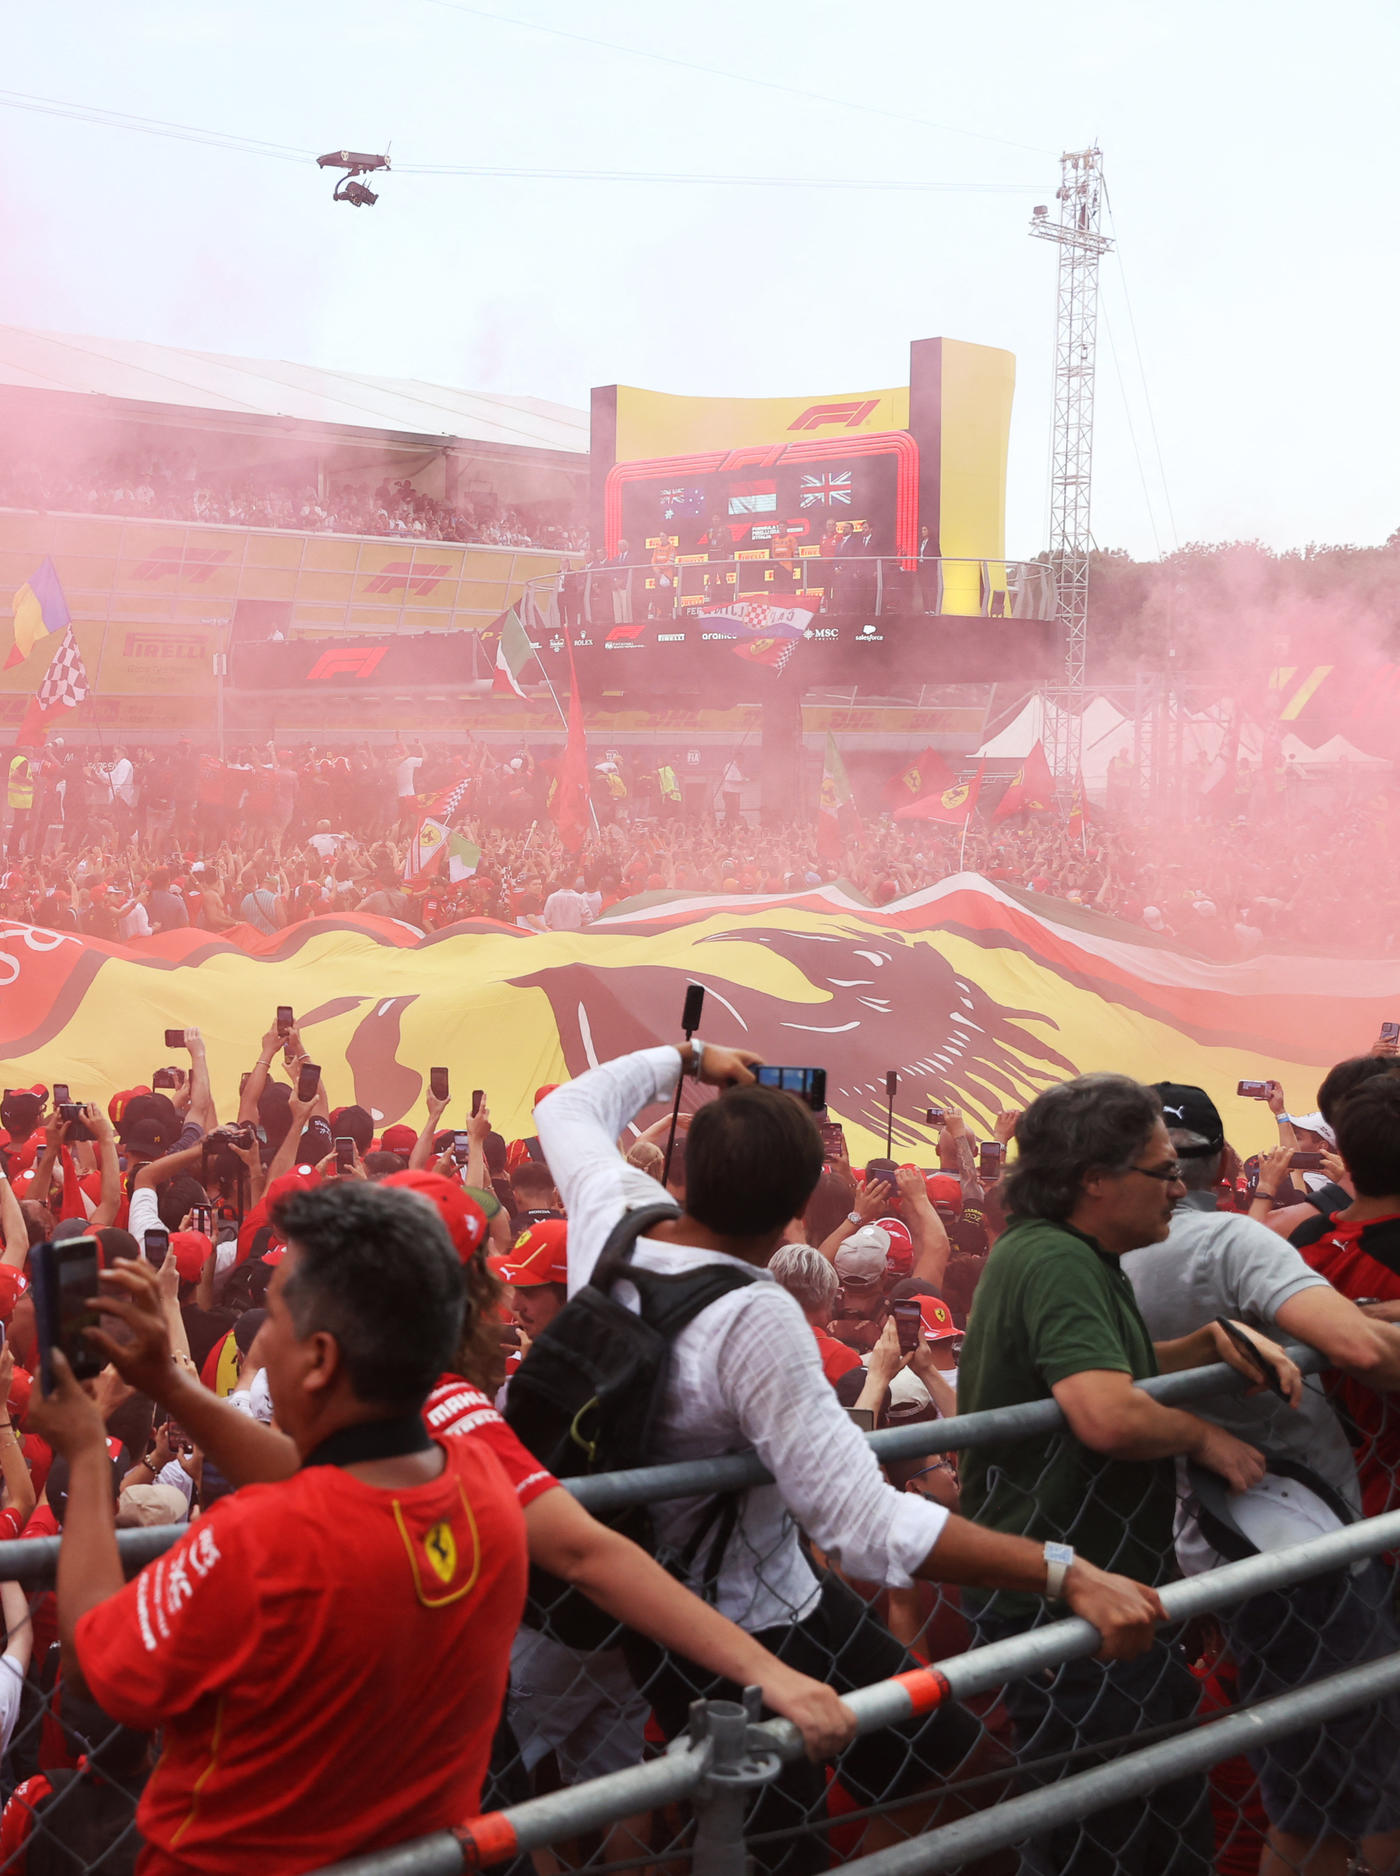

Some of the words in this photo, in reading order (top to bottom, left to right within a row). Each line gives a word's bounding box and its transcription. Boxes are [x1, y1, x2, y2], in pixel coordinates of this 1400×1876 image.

[786, 398, 881, 431] F1
[814, 628, 839, 638] MSC
[855, 634, 884, 642] salesforce
[122, 632, 209, 658] PIRELLI
[573, 639, 594, 647] ROLEX
[306, 646, 390, 682] F1
